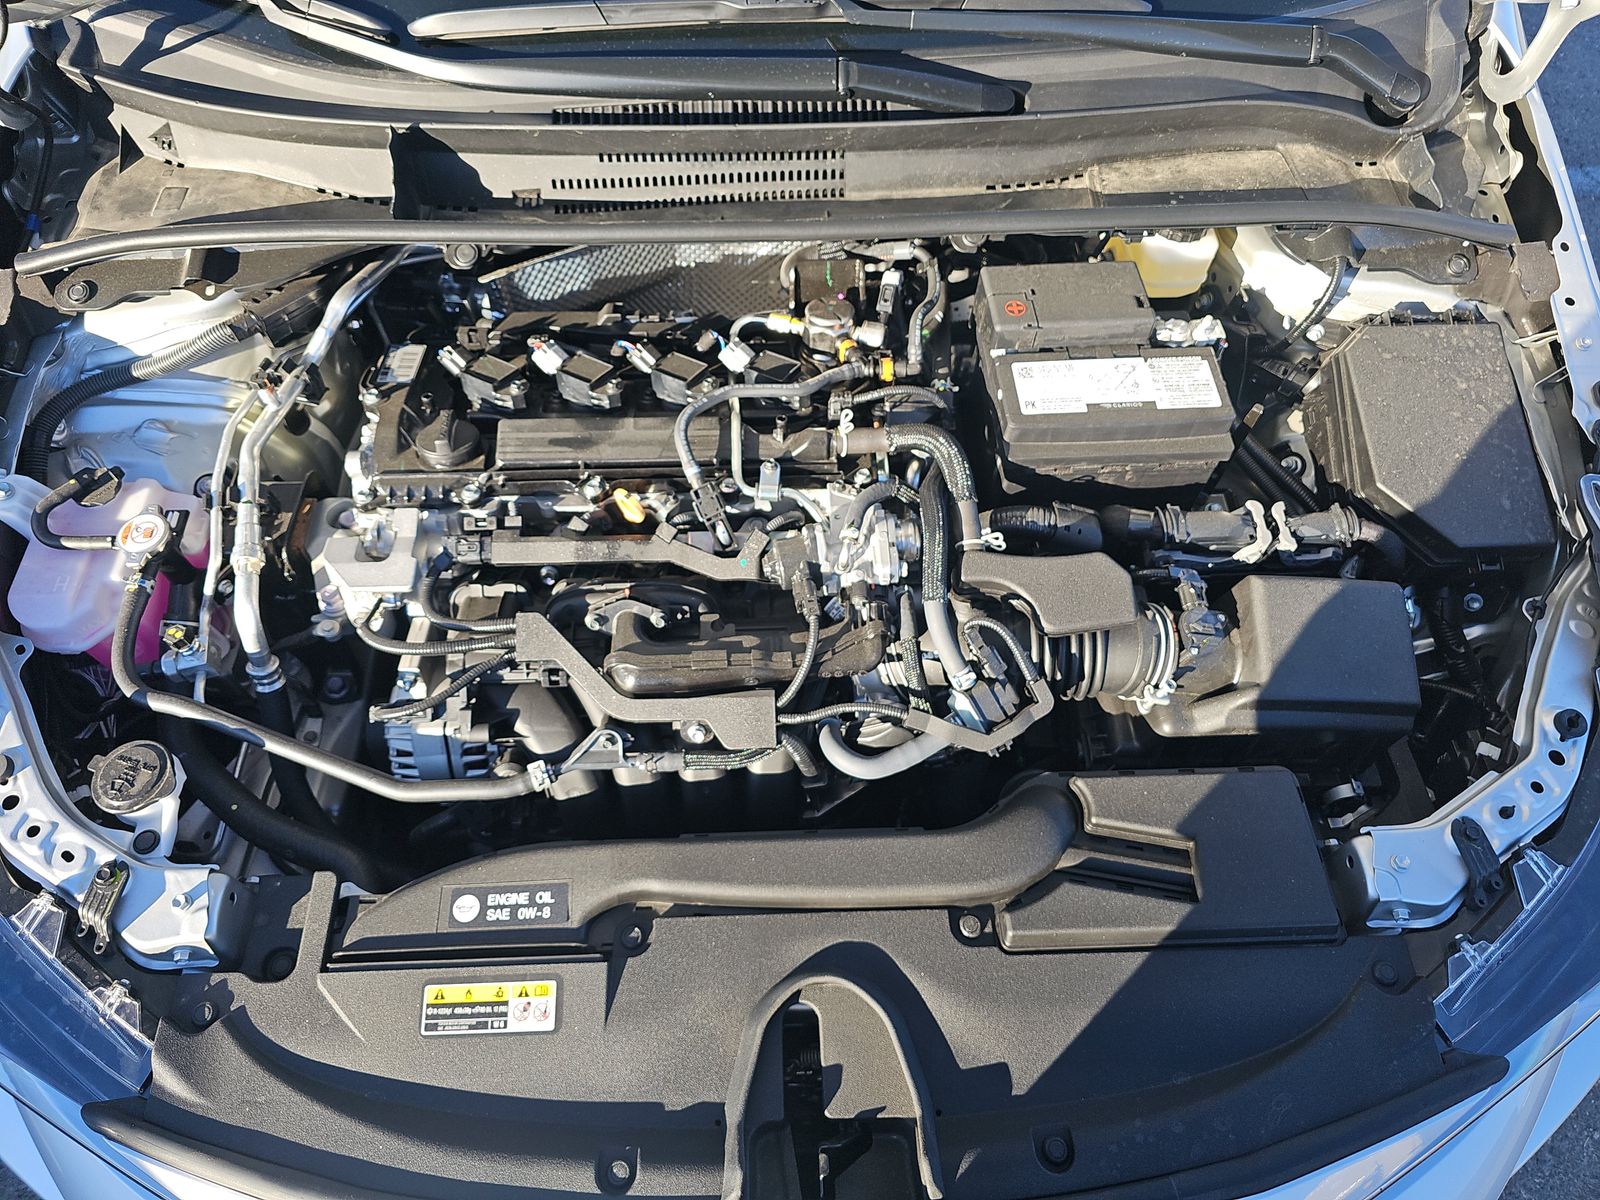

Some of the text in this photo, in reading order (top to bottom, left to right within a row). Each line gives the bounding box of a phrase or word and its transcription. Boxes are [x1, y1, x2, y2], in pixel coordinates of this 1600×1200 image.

[1024, 400, 1037, 409] PK
[487, 891, 555, 906] ENGINE OIL
[486, 908, 511, 921] SAE
[517, 906, 551, 920] 0W-8
